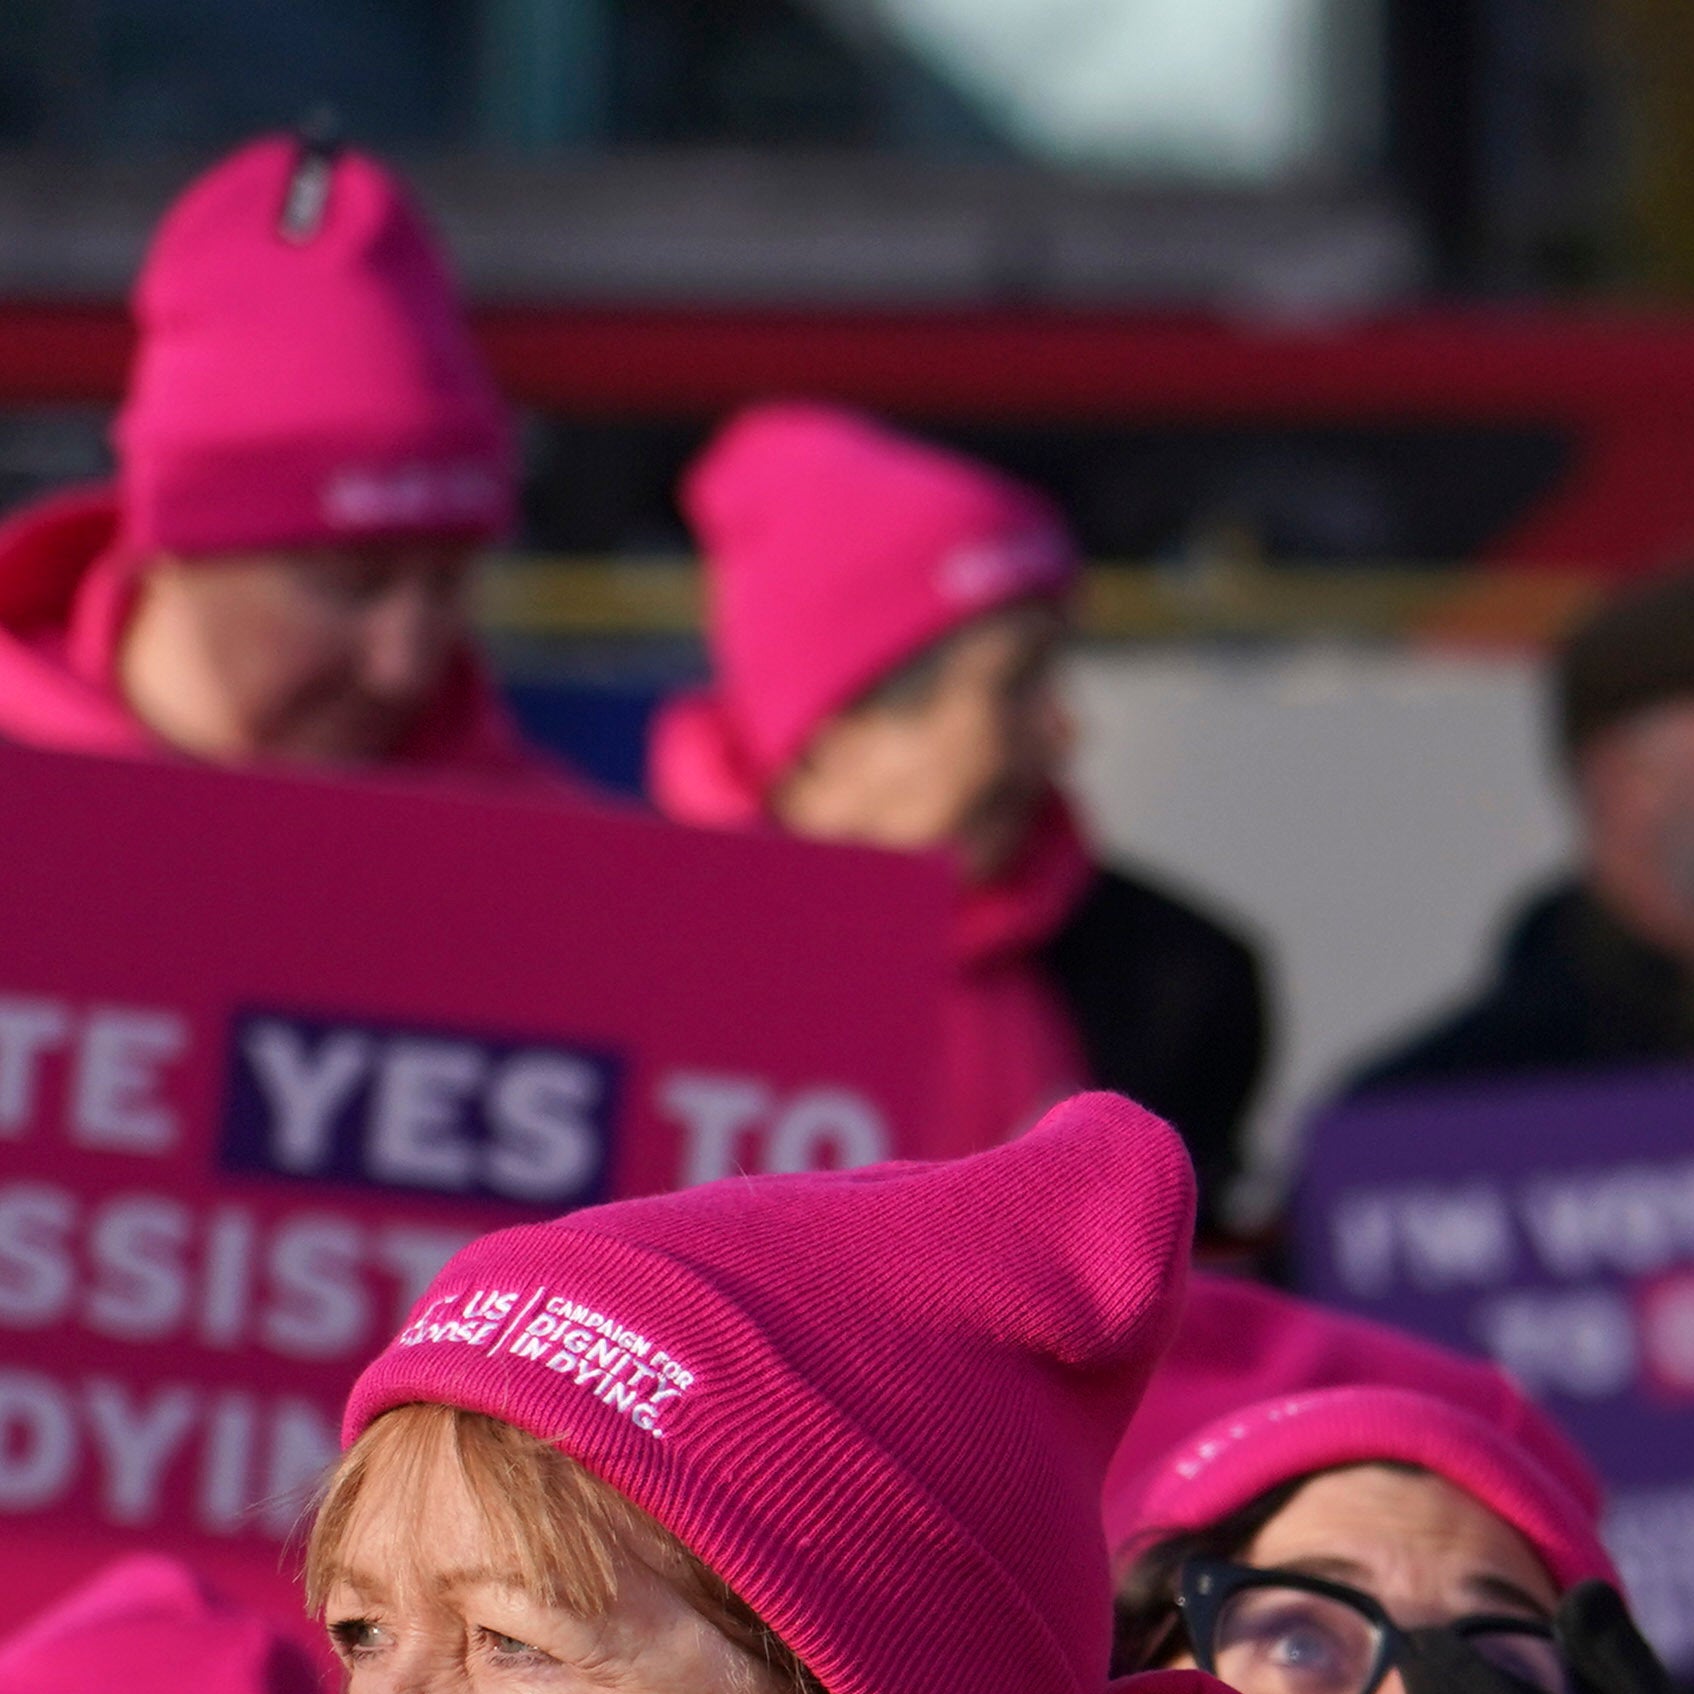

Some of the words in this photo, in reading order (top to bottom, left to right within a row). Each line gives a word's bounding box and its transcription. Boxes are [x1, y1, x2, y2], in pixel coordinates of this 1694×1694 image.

[238, 1017, 604, 1198] YES
[656, 1068, 892, 1186] TO
[463, 1290, 519, 1320] US
[547, 1296, 653, 1357] CAMPAIGN
[650, 1350, 695, 1391] FOR
[509, 1332, 553, 1361] IN
[546, 1349, 665, 1439] DYING.
[525, 1312, 683, 1404] DIGNITY
